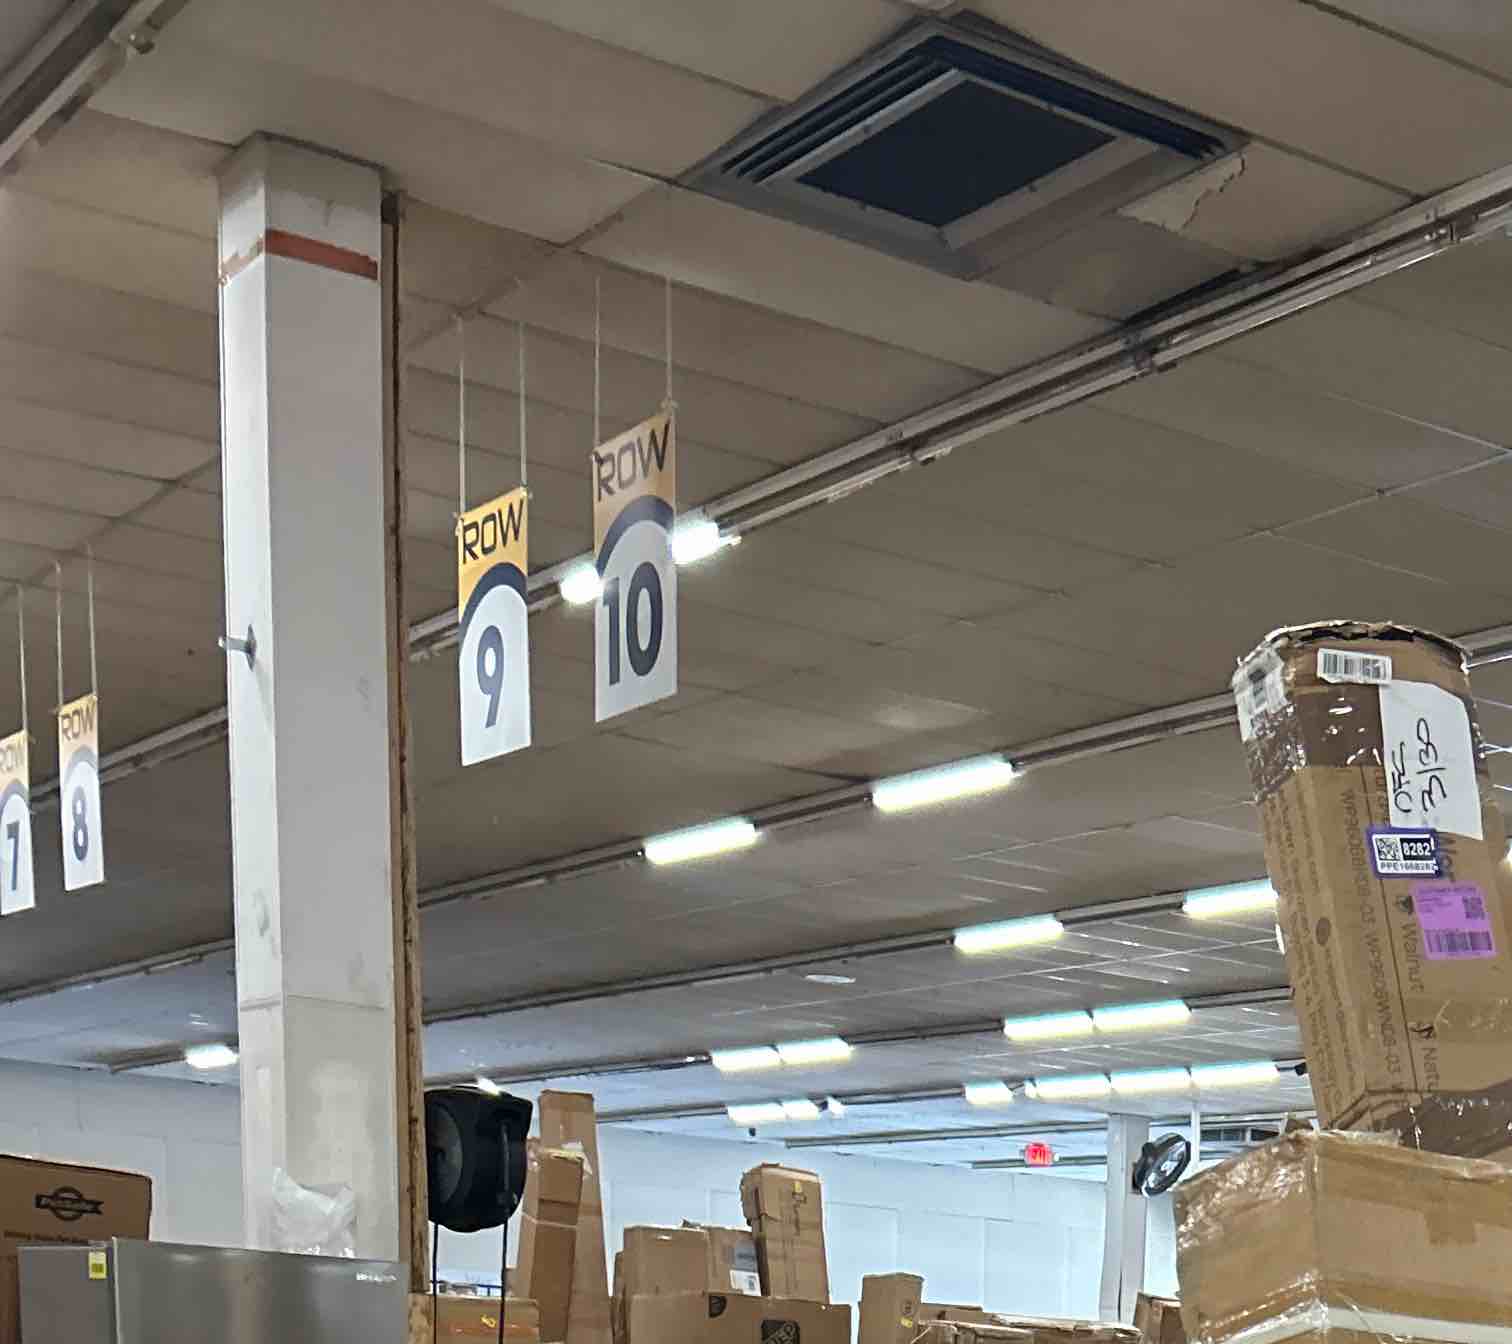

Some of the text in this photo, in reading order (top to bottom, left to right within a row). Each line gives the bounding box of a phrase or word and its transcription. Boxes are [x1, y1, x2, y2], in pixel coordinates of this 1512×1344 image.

[598, 422, 671, 501] ROW
[461, 499, 524, 562] ROW
[602, 561, 663, 688] 10
[476, 625, 505, 729] 9
[61, 702, 96, 741] ROW
[71, 786, 89, 862] 8
[1402, 841, 1431, 857] 8282
[1400, 921, 1425, 994] Walnut
